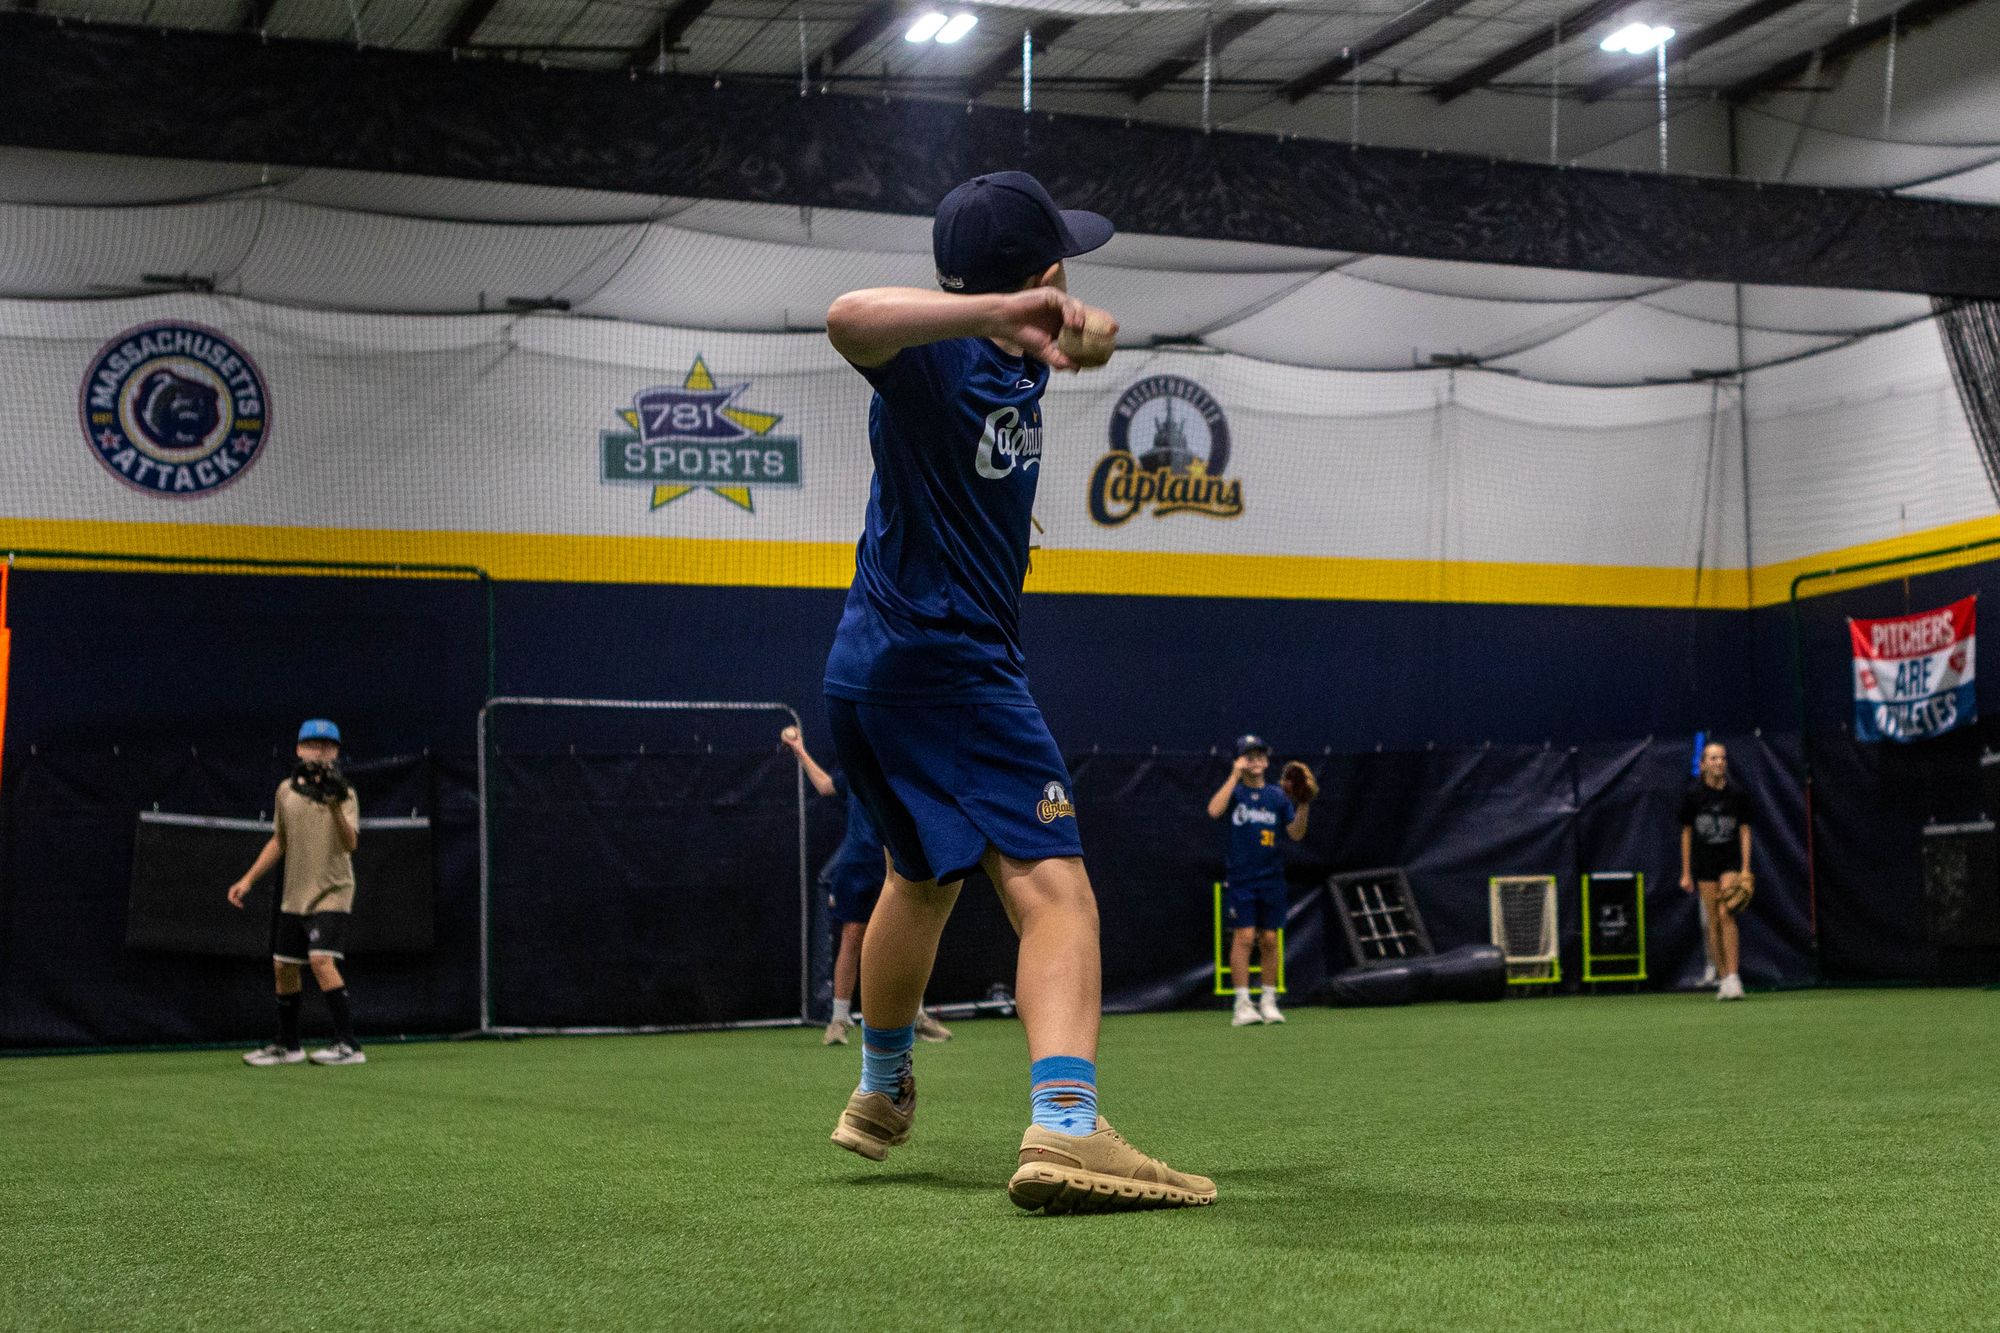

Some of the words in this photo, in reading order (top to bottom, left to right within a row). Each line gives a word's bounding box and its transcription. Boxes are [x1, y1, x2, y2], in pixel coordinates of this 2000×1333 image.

[90, 330, 260, 416] MASSACHUSETTS
[643, 403, 714, 430] 781
[111, 448, 240, 490] ATTACK
[624, 442, 785, 477] SPORTS
[1088, 451, 1244, 526] Captains
[1871, 610, 1956, 657] PITCHERS
[1894, 657, 1933, 694] ARE
